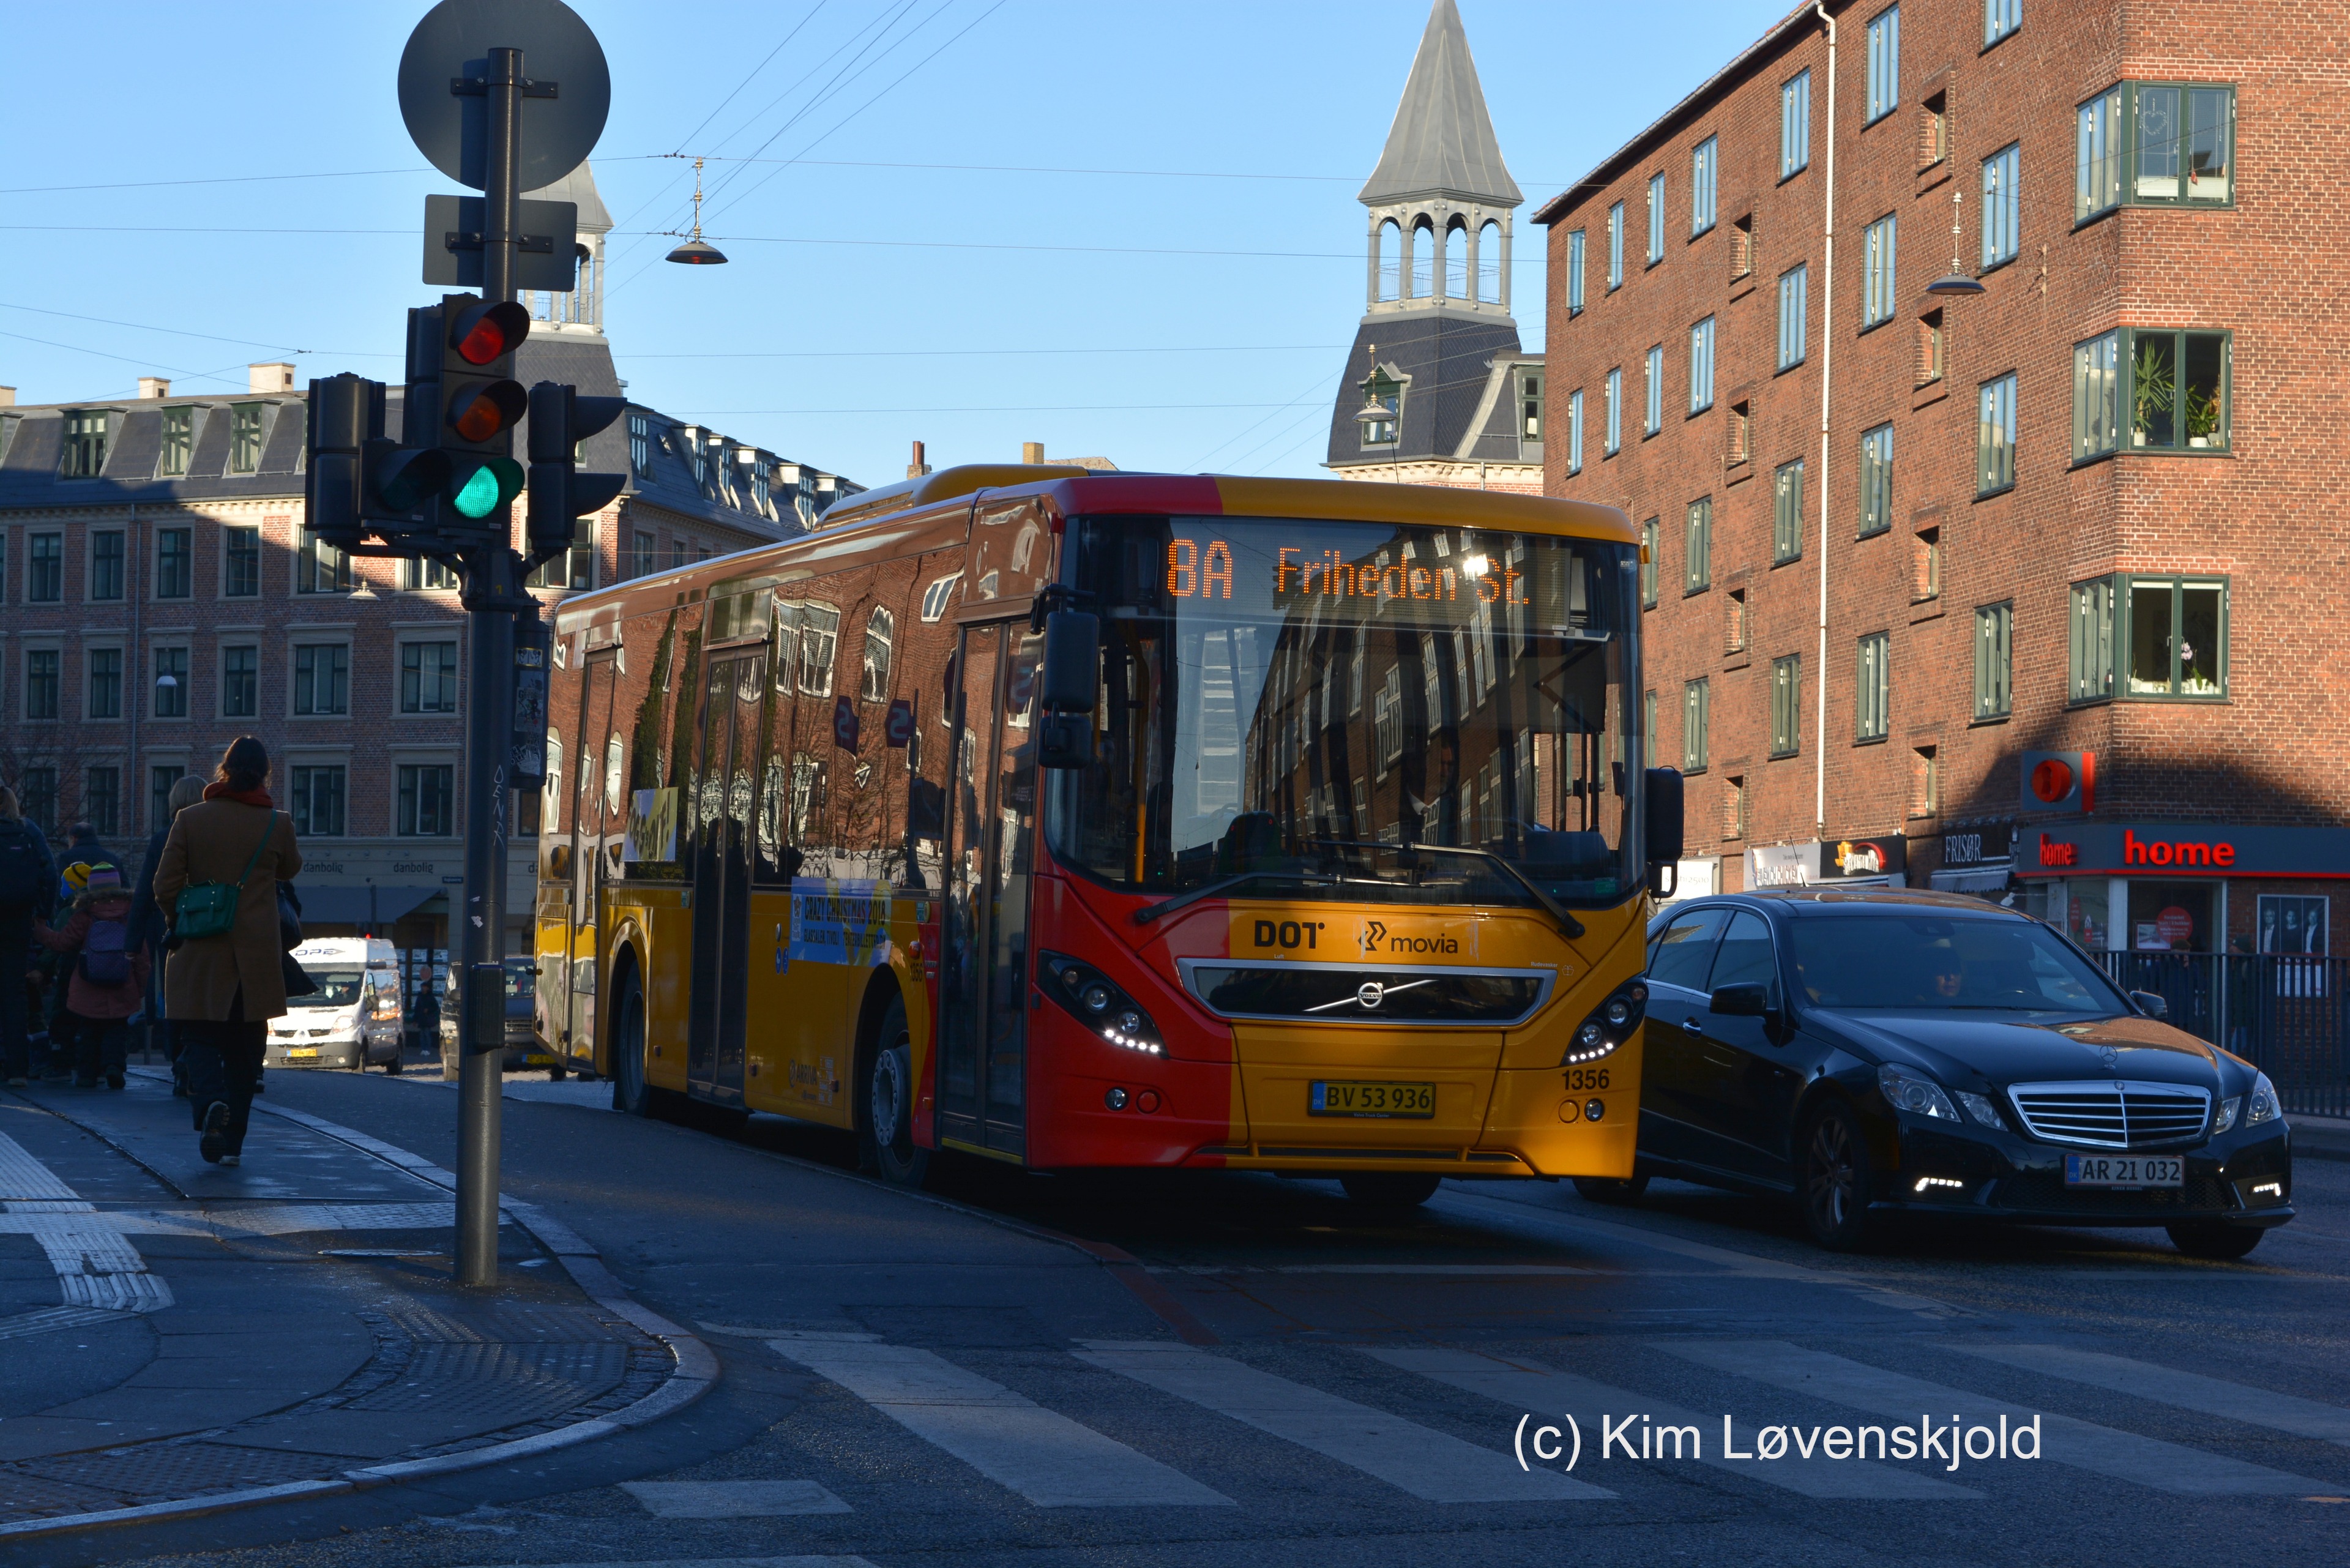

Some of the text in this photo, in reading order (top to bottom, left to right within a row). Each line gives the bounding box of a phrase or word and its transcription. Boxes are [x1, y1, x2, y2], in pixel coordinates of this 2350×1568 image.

[1167, 539, 1529, 605] 8A Friheden St.
[1945, 834, 1981, 863] FRISØR
[2040, 833, 2075, 867] home
[2124, 829, 2236, 867] home
[304, 862, 343, 874] danbolig
[394, 862, 433, 874] danbolig
[1665, 875, 1709, 884] sshi2500
[805, 896, 886, 926] CRAZY CHRISTMAS 2018
[1255, 920, 1458, 954] DOT movia
[1562, 1069, 1610, 1090] 1356
[1327, 1087, 1355, 1107] BV
[1361, 1088, 1386, 1108] 53
[1392, 1088, 1430, 1109] 936
[2082, 1160, 2109, 1180] AR
[2116, 1160, 2138, 1181] 21
[2146, 1160, 2180, 1181] 032
